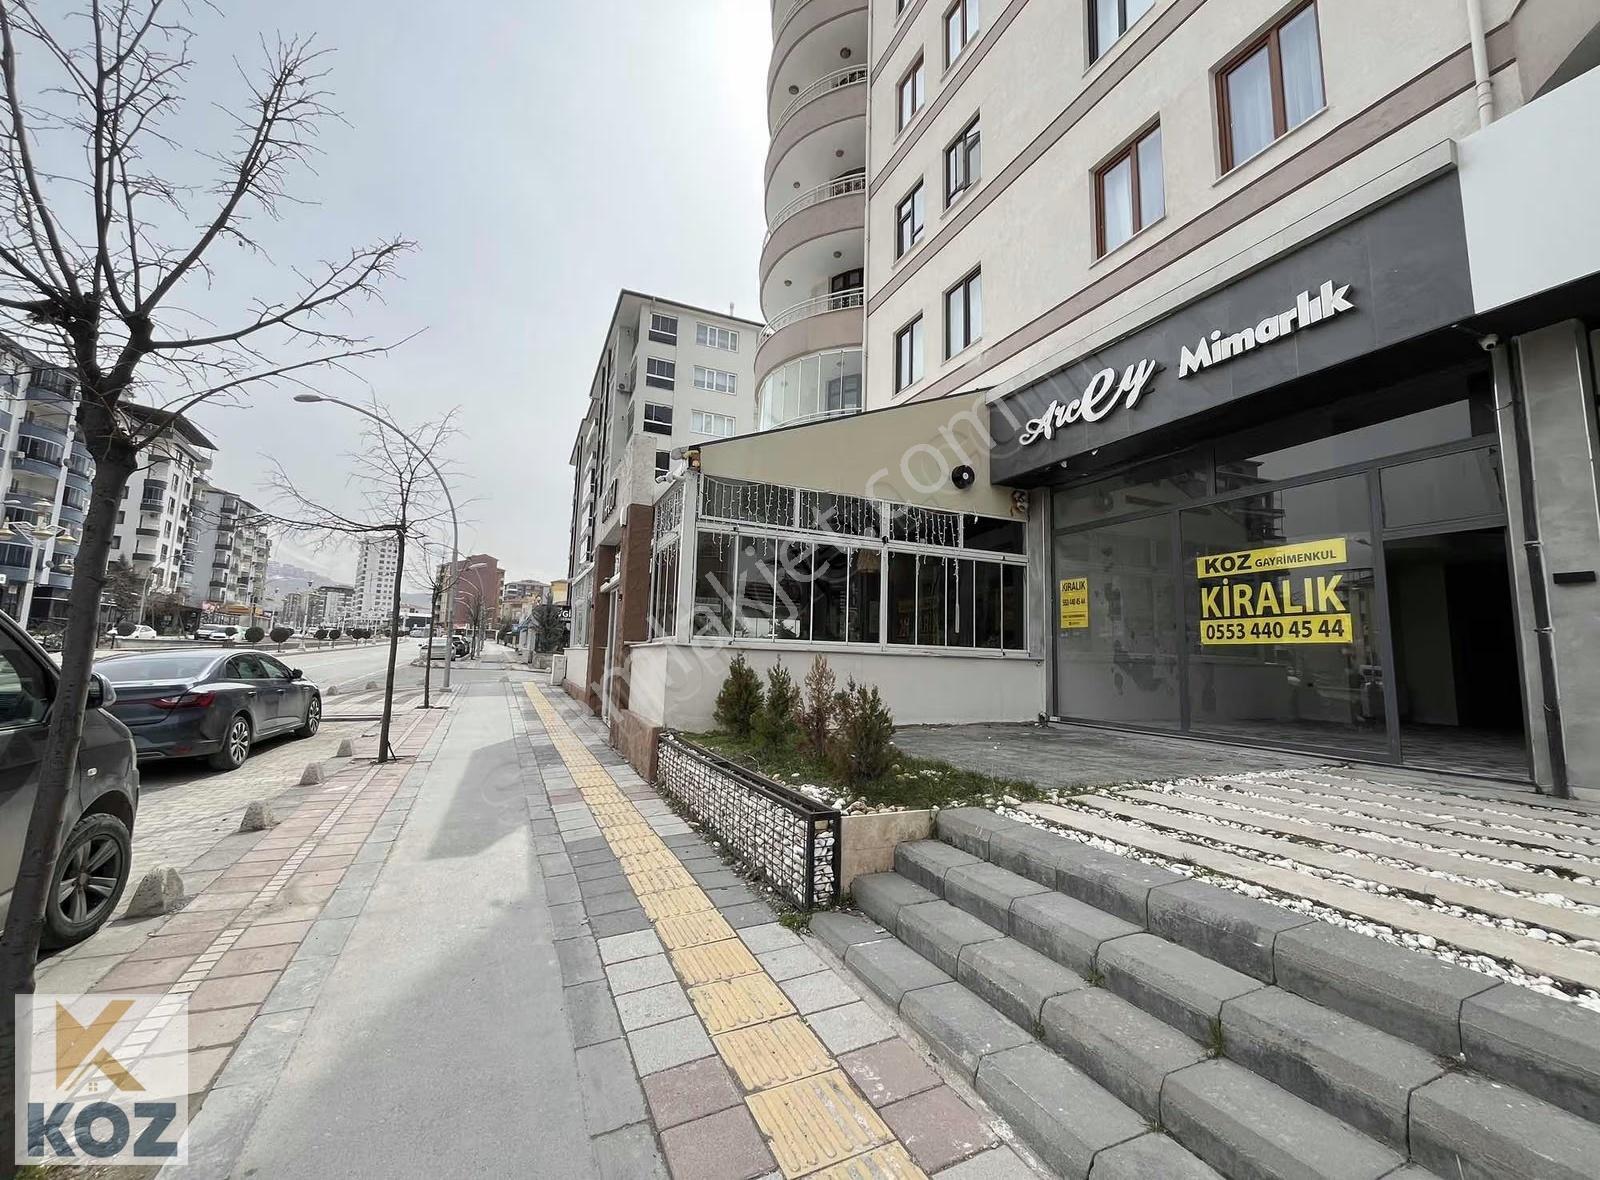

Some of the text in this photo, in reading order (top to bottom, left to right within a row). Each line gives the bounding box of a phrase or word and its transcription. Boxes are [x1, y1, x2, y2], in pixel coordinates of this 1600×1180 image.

[1178, 280, 1355, 379] Mimarlık
[1205, 550, 1337, 574] KOZ GAYRİMENKUL
[1201, 574, 1346, 618] KİRALIK
[1206, 619, 1345, 640] 0553 440 45 44
